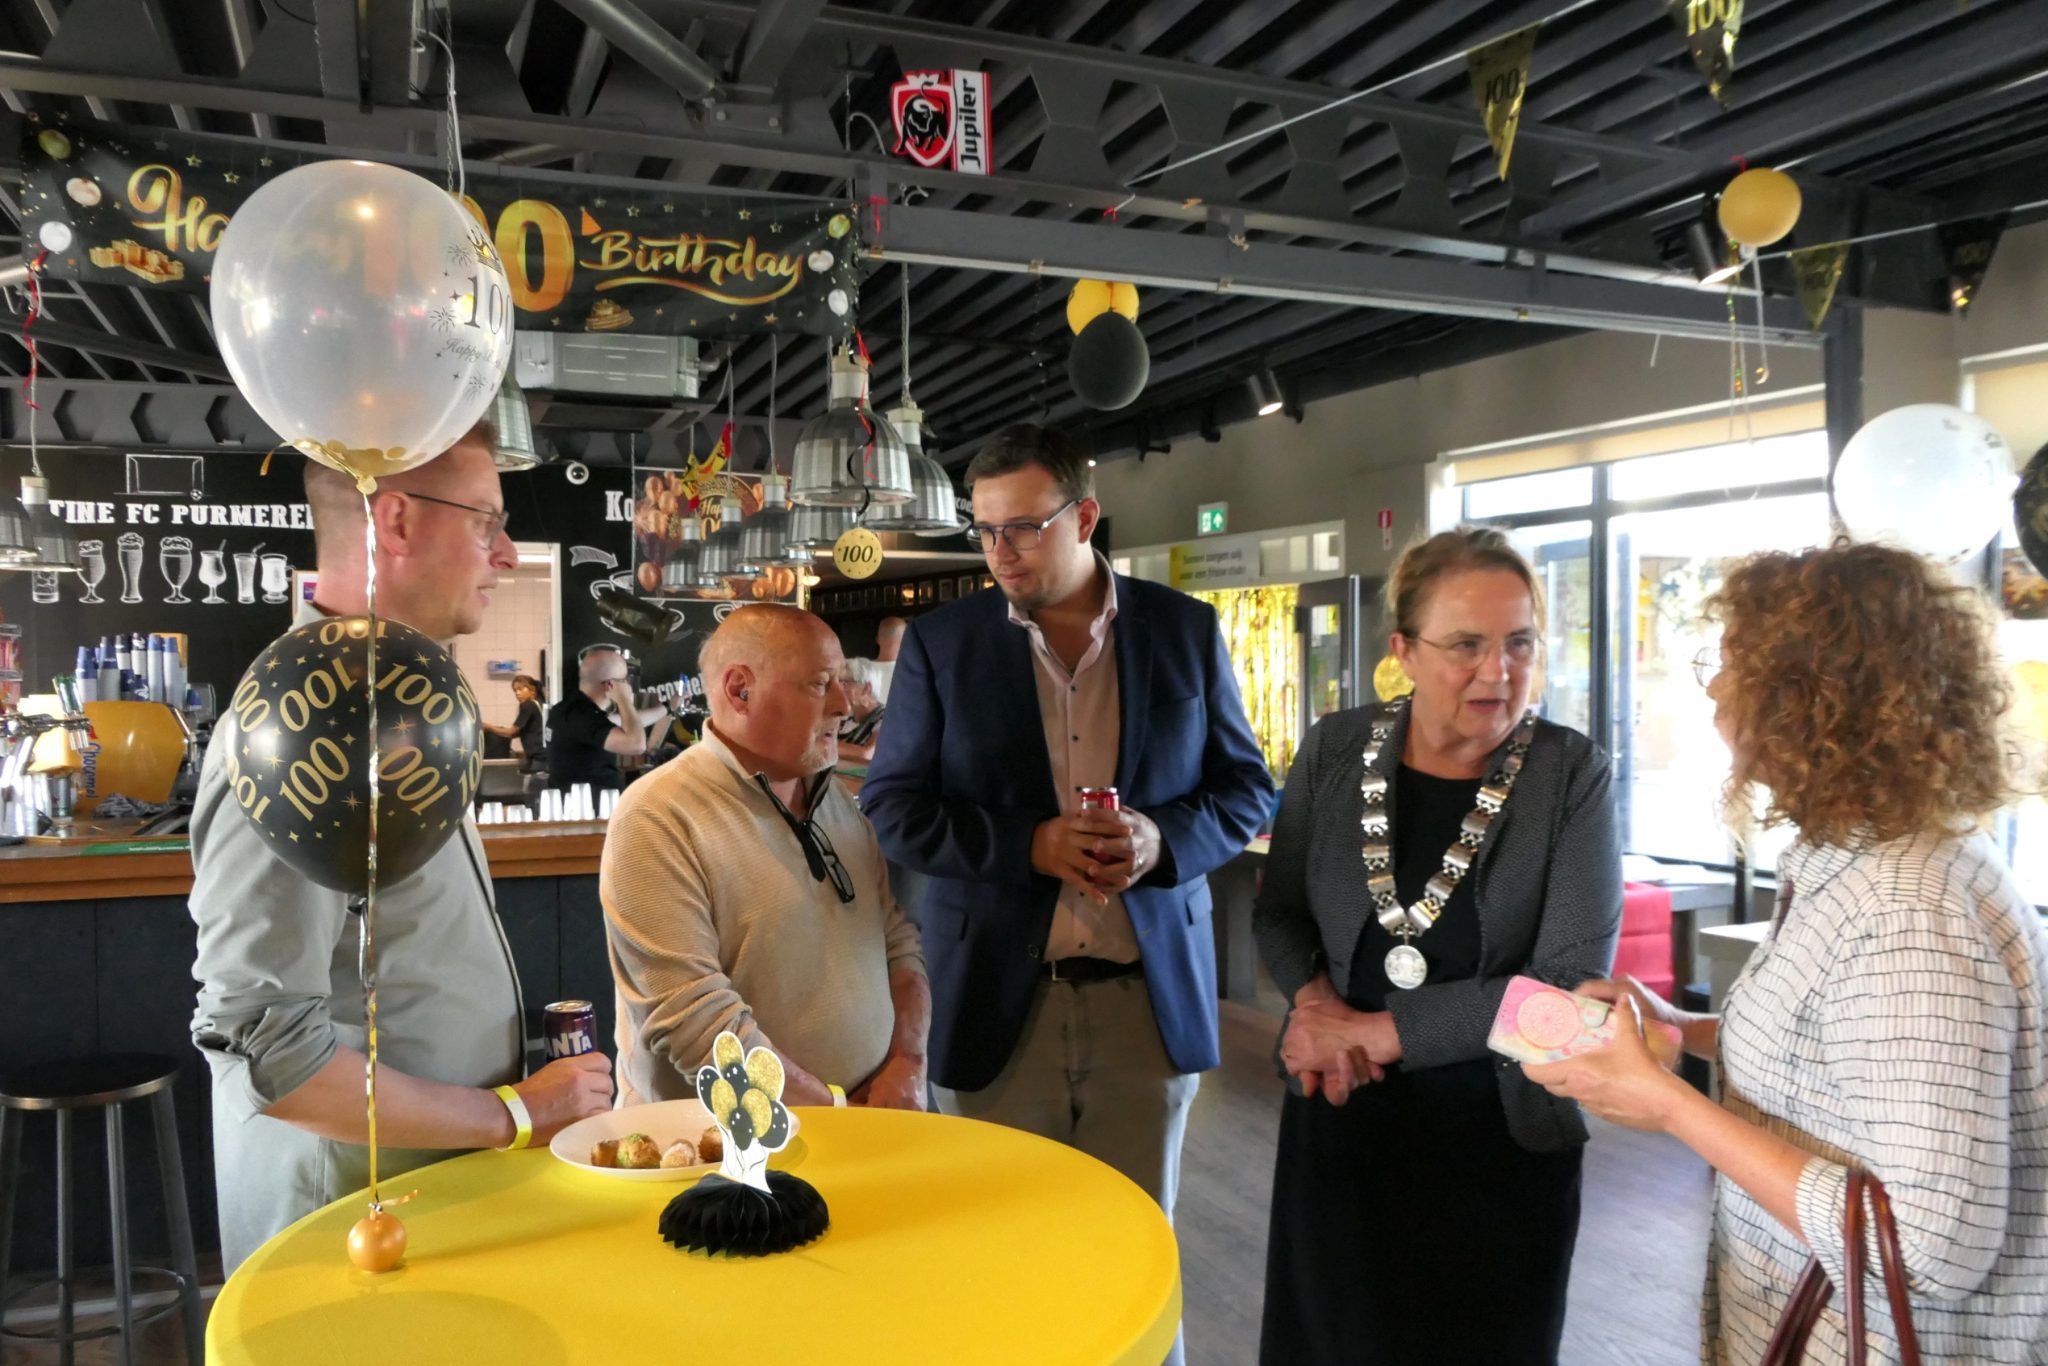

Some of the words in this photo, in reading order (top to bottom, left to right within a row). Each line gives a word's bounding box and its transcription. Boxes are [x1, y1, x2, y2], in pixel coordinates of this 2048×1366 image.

[1484, 68, 1520, 108] 100
[959, 78, 982, 171] Jupiler
[579, 230, 804, 305] Birthday
[126, 503, 160, 524] FC
[842, 545, 873, 563] 100
[279, 657, 358, 732] 100
[375, 662, 454, 726] 100
[279, 736, 349, 822] 100
[377, 745, 449, 816] 100
